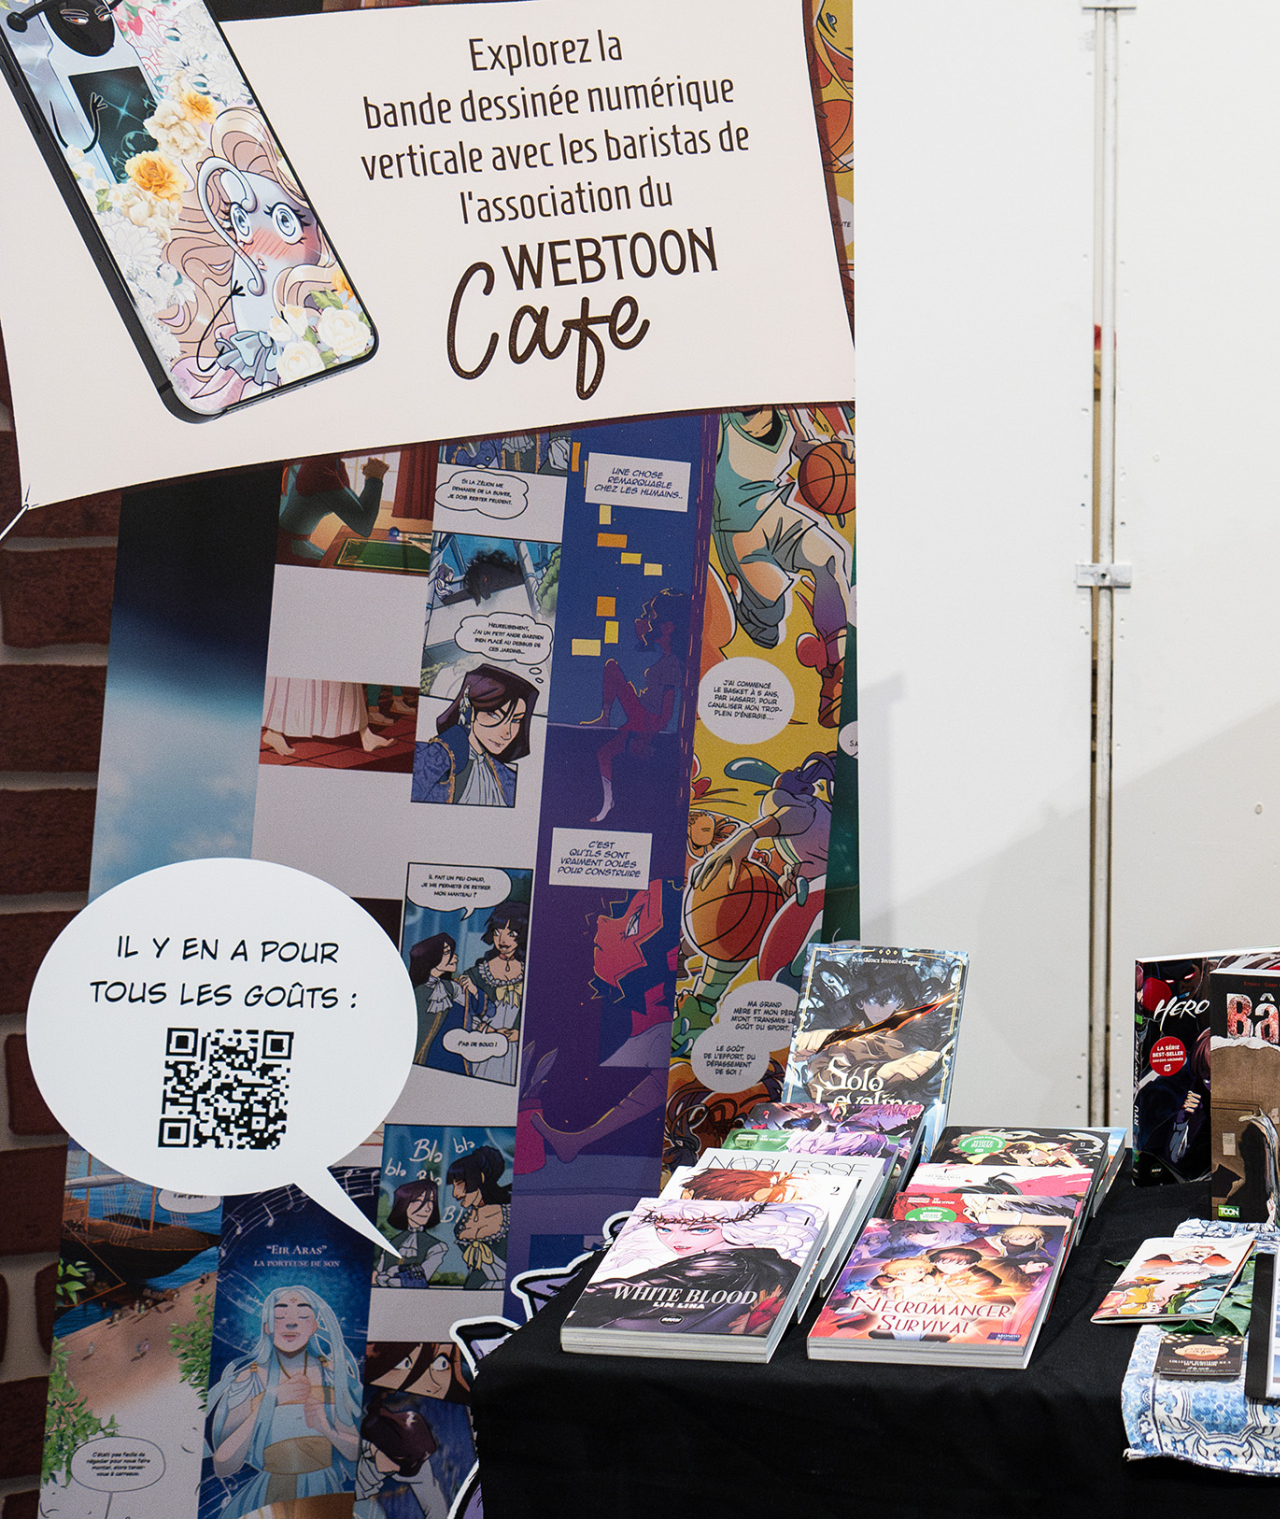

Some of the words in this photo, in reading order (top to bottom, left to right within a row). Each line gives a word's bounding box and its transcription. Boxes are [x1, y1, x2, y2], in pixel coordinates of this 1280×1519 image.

[468, 32, 592, 76] Explorez
[598, 30, 622, 61] la
[363, 91, 451, 129] bande
[459, 84, 580, 122] dessinée
[587, 77, 734, 112] numérique
[361, 142, 483, 180] verticale
[492, 139, 554, 171] avec
[560, 134, 597, 166] les
[604, 125, 710, 161] baristas
[719, 120, 750, 152] de
[460, 182, 632, 224] l'association
[639, 176, 673, 208] du
[501, 226, 718, 290] WEBTOON
[607, 476, 672, 489] REMARQUABLE
[612, 468, 630, 476] UNE
[632, 470, 663, 479] CHOSE
[594, 484, 618, 492] CHEZ
[737, 681, 772, 689] COMMENCÉ
[708, 702, 743, 710] CANALISER
[569, 848, 601, 857] QU'ILS
[604, 851, 630, 859] SONT
[589, 841, 615, 849] C'EST
[558, 866, 583, 874] POUR
[585, 868, 641, 878] CONSTRUIRE
[117, 936, 138, 958] IL
[153, 938, 170, 958] Y
[182, 938, 219, 963] EN
[230, 940, 248, 962] A
[261, 941, 340, 964] POUR
[90, 981, 168, 1005] TOUS
[180, 984, 232, 1006] LES
[245, 982, 339, 1009] GOÛTS
[1153, 996, 1210, 1031] HERO
[818, 1053, 884, 1092] Solo
[830, 1186, 840, 1195] 2
[1219, 1207, 1239, 1216] TOON
[614, 1285, 686, 1303] WHITE
[688, 1290, 758, 1305] BLOOD
[851, 1296, 1011, 1318] NECROMANCER
[876, 1314, 969, 1334] SURVIVAL
